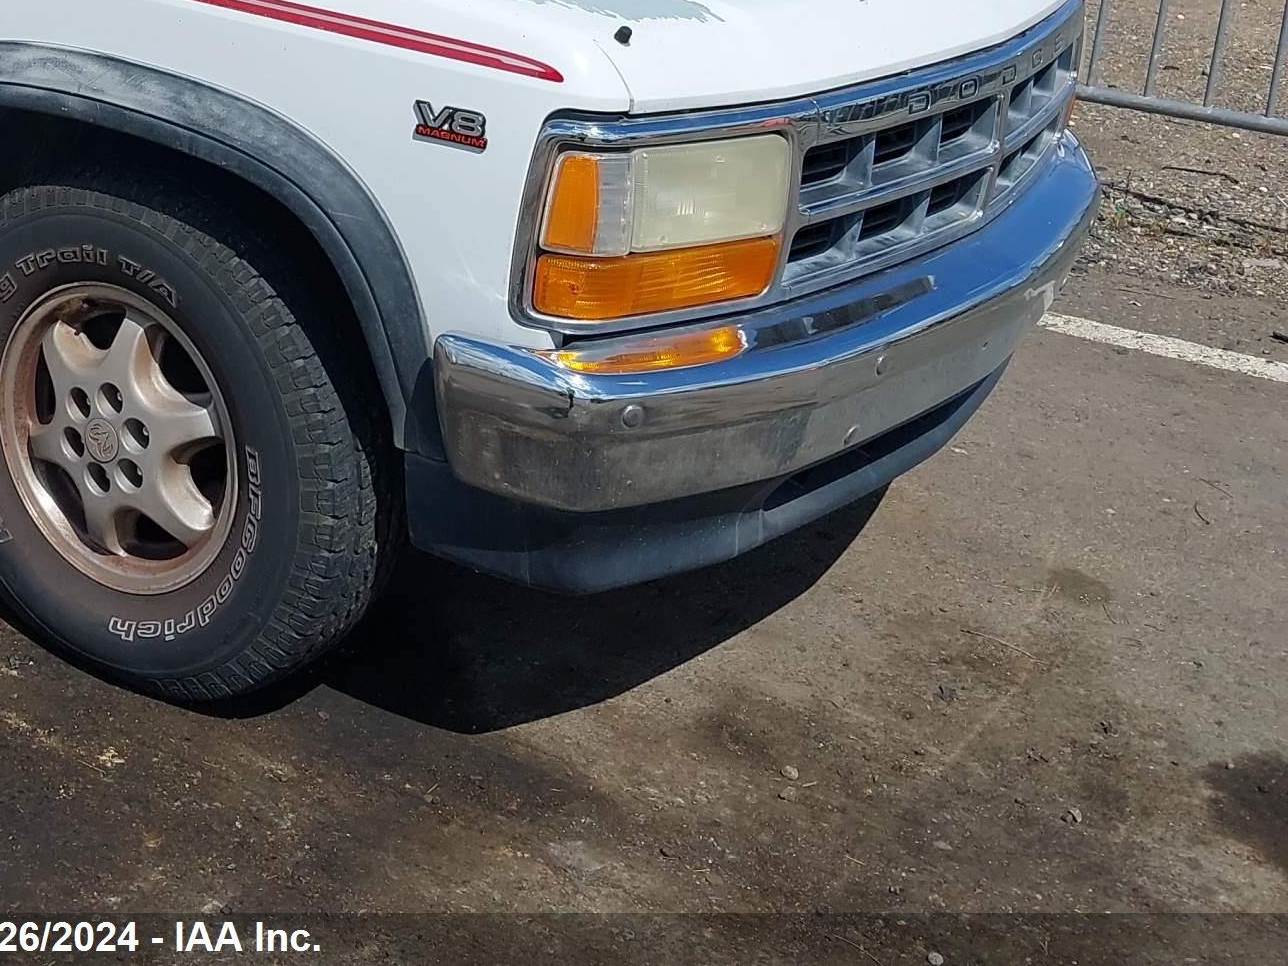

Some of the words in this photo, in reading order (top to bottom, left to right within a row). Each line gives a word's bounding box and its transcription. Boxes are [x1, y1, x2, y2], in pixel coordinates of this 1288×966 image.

[907, 34, 1064, 116] DODGE
[413, 99, 487, 137] V8
[417, 125, 486, 148] MAGNUM
[14, 244, 109, 277] Trail
[116, 253, 178, 308] T/A
[108, 444, 262, 642] BFGoodrich
